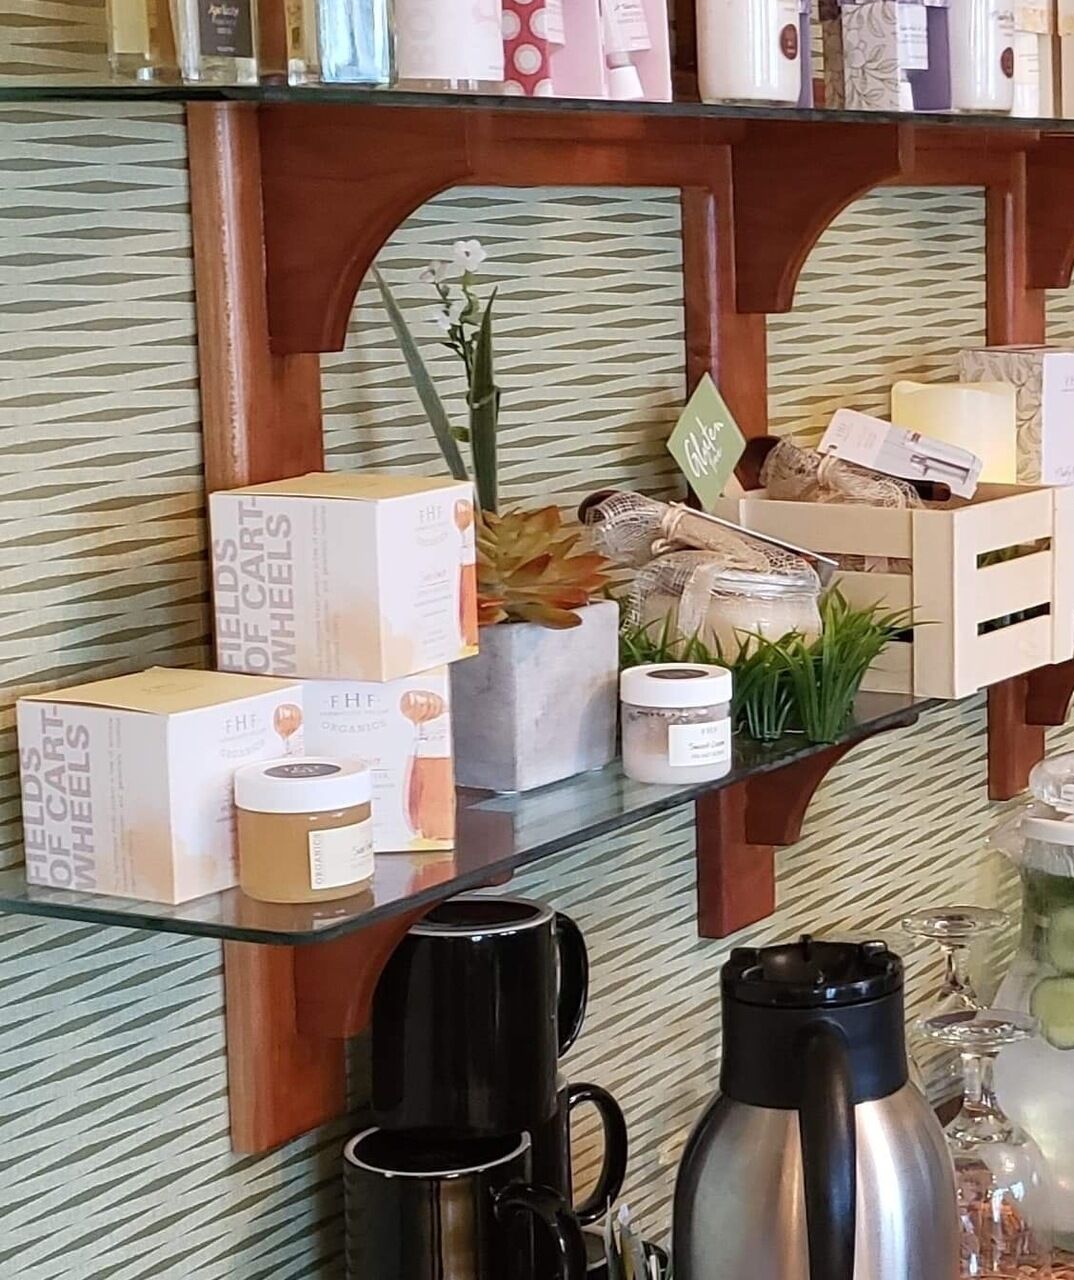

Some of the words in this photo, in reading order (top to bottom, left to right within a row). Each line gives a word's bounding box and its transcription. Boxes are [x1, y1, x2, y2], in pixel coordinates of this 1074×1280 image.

[214, 538, 244, 671] FIELDS
[238, 497, 269, 610] CART-
[265, 513, 297, 674] WHEELS
[244, 622, 270, 674] OF
[331, 693, 375, 709] FHF
[21, 745, 48, 884] FIELDS
[41, 705, 69, 822] CART-
[66, 725, 97, 889] WHEELS
[48, 834, 73, 887] OF
